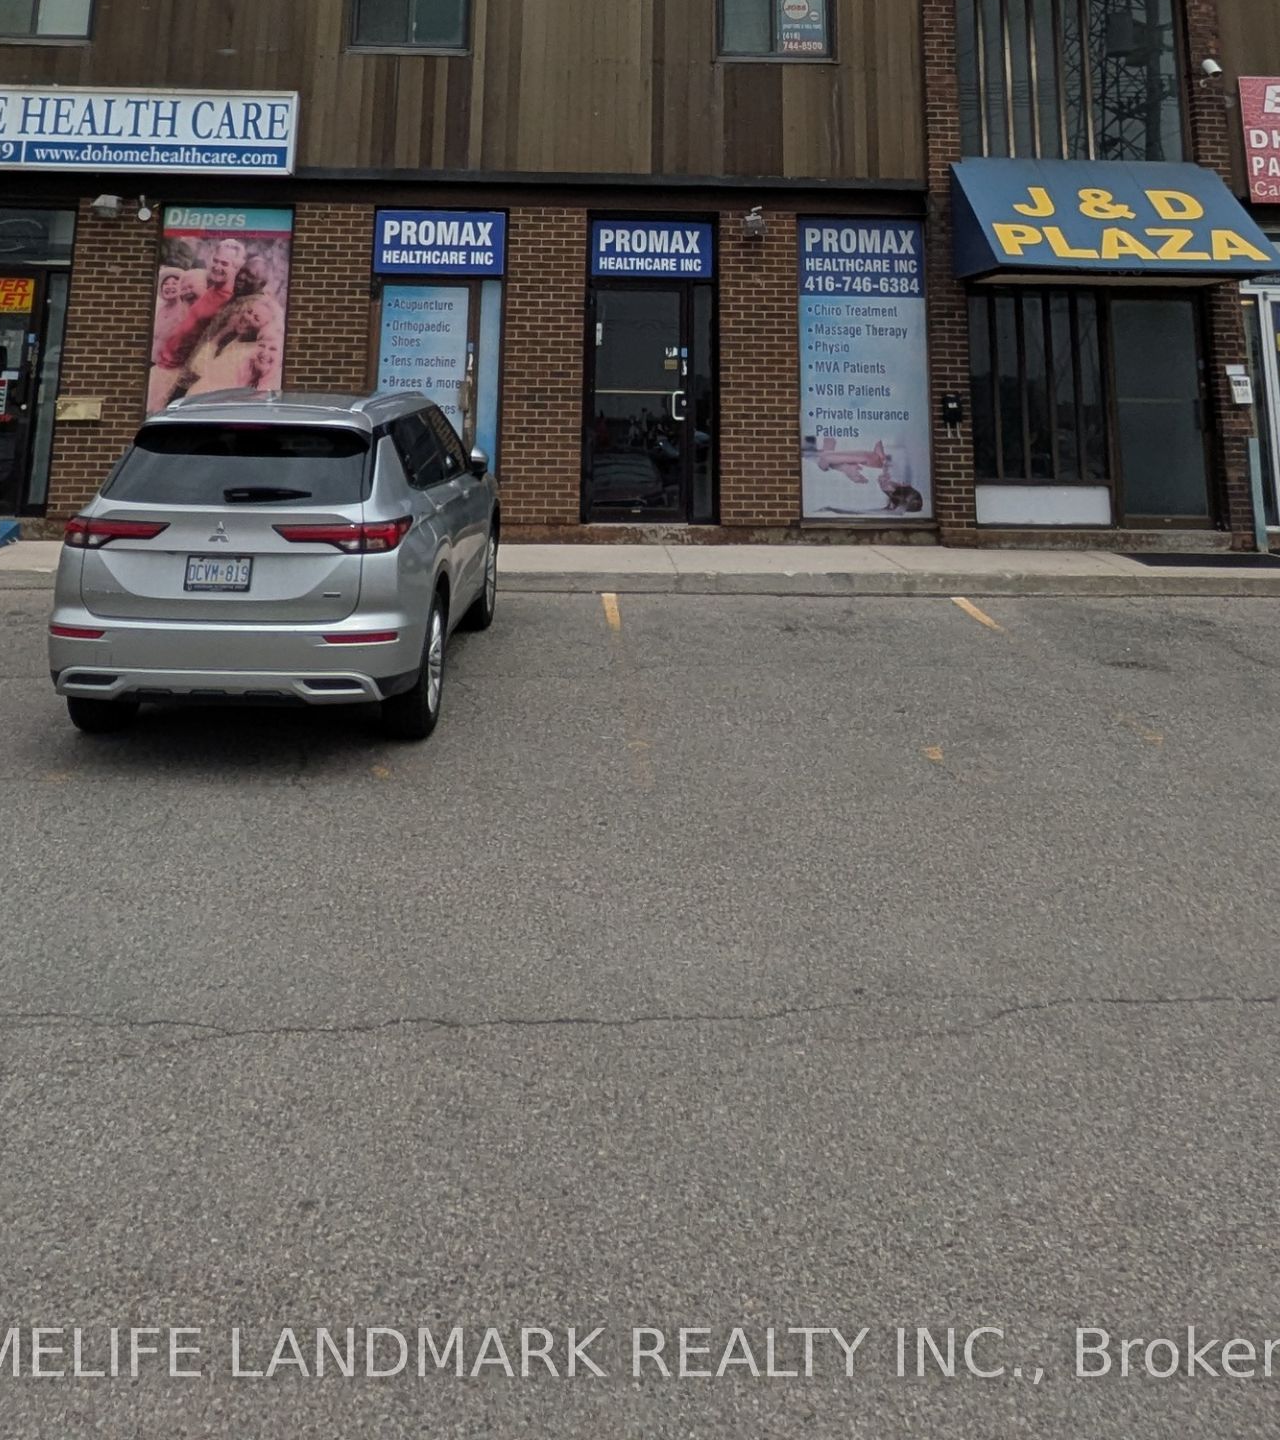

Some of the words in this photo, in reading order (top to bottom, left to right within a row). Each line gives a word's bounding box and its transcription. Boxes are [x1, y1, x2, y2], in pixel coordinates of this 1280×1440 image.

[17, 97, 181, 138] HEALTH
[191, 101, 289, 140] CARE
[34, 144, 278, 165] www.dohomehealthcare.com
[1013, 186, 1057, 218] J
[1077, 188, 1137, 220] &
[1144, 189, 1204, 220] D
[168, 209, 246, 228] Diapers
[383, 220, 493, 246] PROMAX
[599, 229, 700, 253] PROMAX
[805, 228, 915, 254] PROMAX
[992, 222, 1272, 261] PLAZA
[382, 250, 466, 265] HEALTHCARE
[471, 251, 494, 266] INC
[599, 257, 677, 271] HEALTHCARE
[681, 259, 702, 271] INC
[805, 258, 890, 273] HEALTHCARE
[894, 260, 918, 274] INC
[805, 276, 920, 293] 416-746-6384
[394, 299, 454, 311] Acupuncture
[814, 304, 842, 316] Chiro
[846, 305, 898, 318] Treatment
[392, 321, 451, 333] Orthopaedic
[815, 324, 862, 339] Massage
[865, 325, 908, 339] Therapy
[392, 336, 421, 347] Shoes
[814, 341, 850, 355] Physio
[390, 355, 412, 366] Tens
[415, 356, 456, 368] machine
[815, 362, 840, 373] MVA
[843, 362, 886, 374] Patients
[389, 376, 422, 388] Braces
[426, 377, 433, 388] &
[436, 379, 461, 389] more
[815, 384, 844, 396] WSIB
[848, 385, 891, 397] Patients
[815, 408, 853, 420] Private
[857, 408, 910, 421] Insurance
[816, 425, 859, 438] Patients
